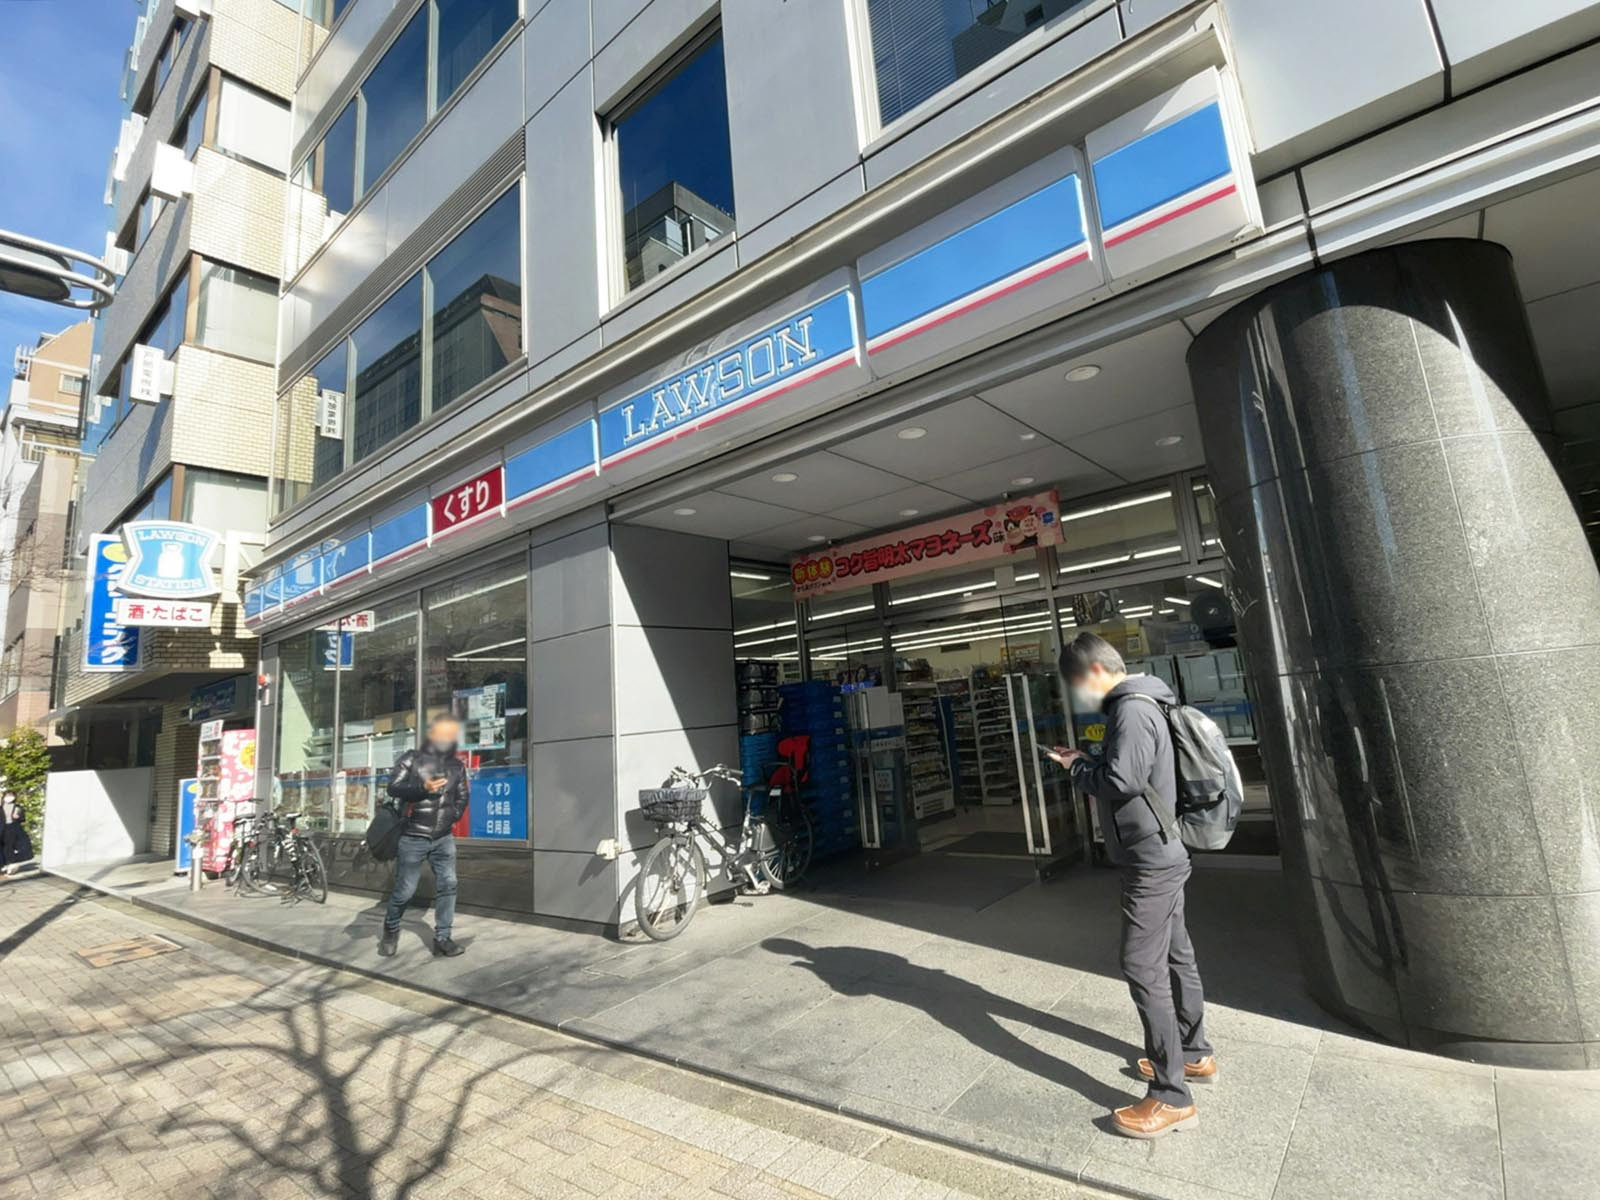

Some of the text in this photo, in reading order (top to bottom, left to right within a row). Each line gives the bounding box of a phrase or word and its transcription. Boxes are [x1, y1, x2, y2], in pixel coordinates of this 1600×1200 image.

[622, 316, 817, 445] LAWSON
[443, 480, 490, 523] くすり
[138, 530, 209, 547] LAWSON
[127, 603, 204, 622] 酒・たばこ
[487, 782, 511, 796] くすり
[486, 800, 511, 816] 化粧品
[486, 820, 511, 835] 日用品
